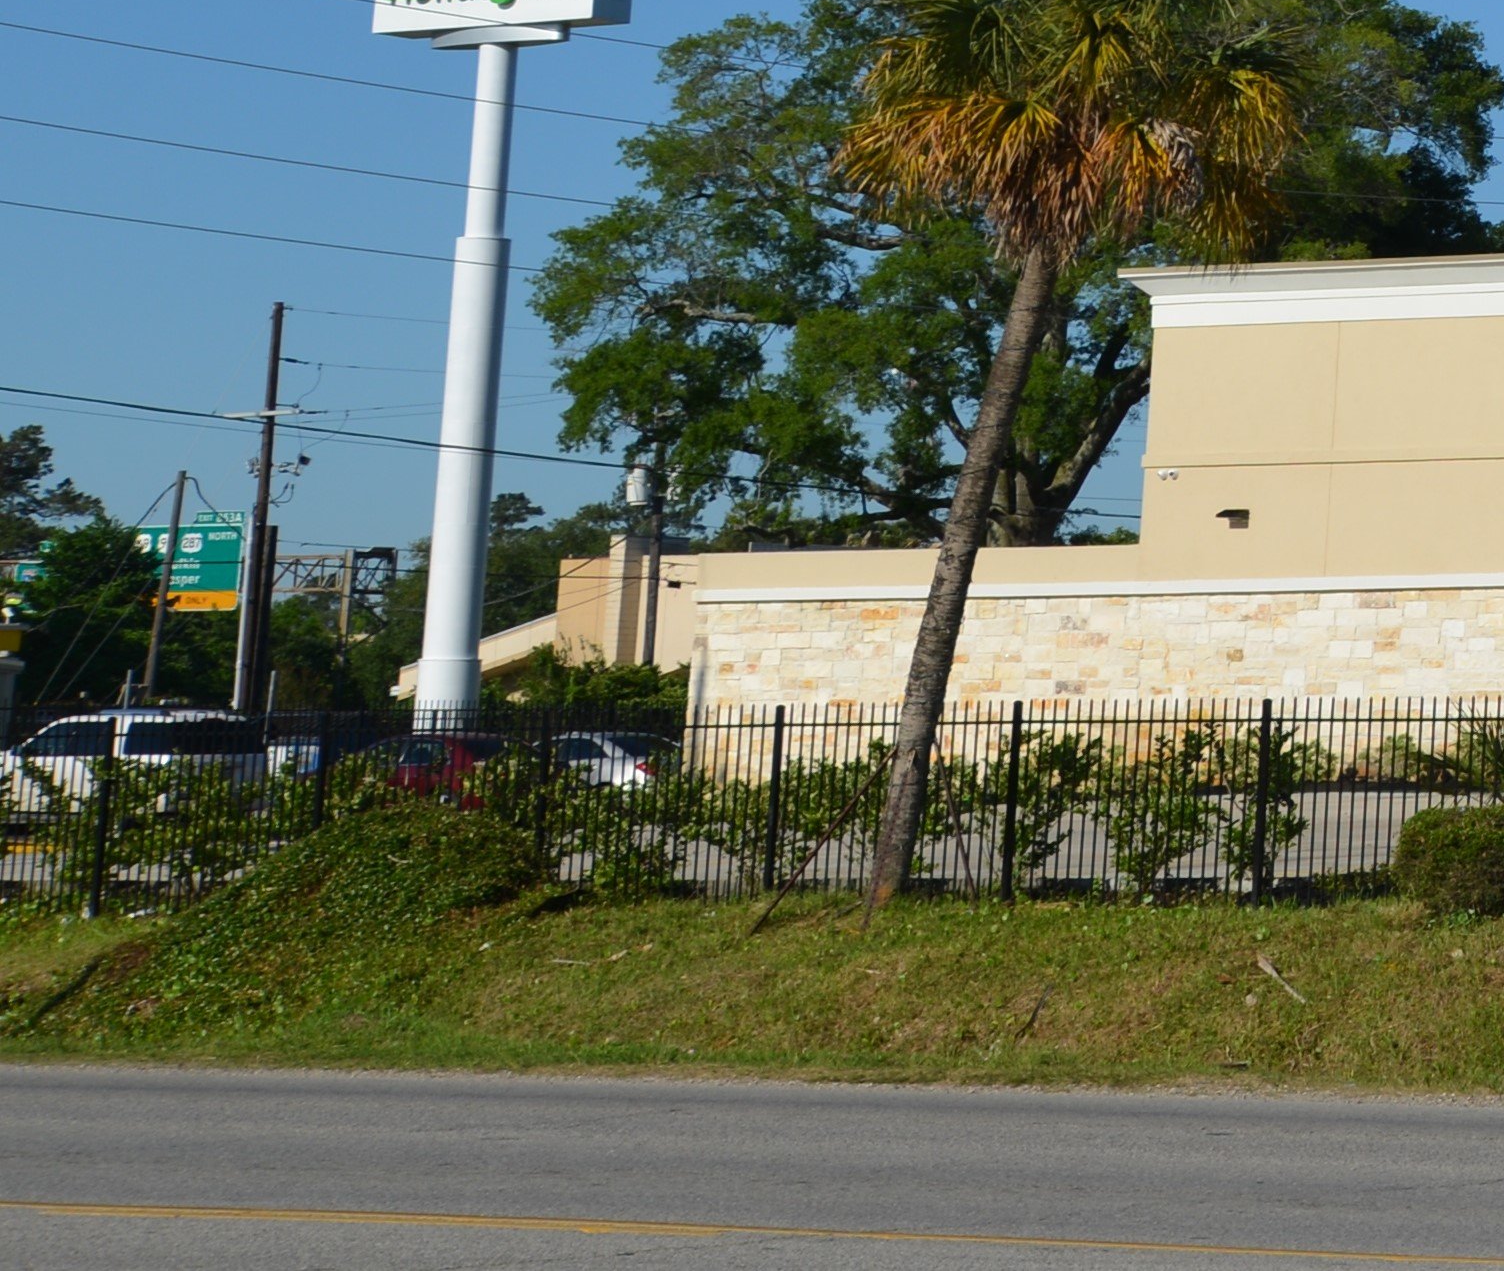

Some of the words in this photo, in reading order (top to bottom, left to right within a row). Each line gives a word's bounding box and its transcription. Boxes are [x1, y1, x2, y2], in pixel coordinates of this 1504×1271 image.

[198, 514, 213, 522] EXIT
[208, 532, 238, 540] NORTH
[169, 576, 201, 587] asper
